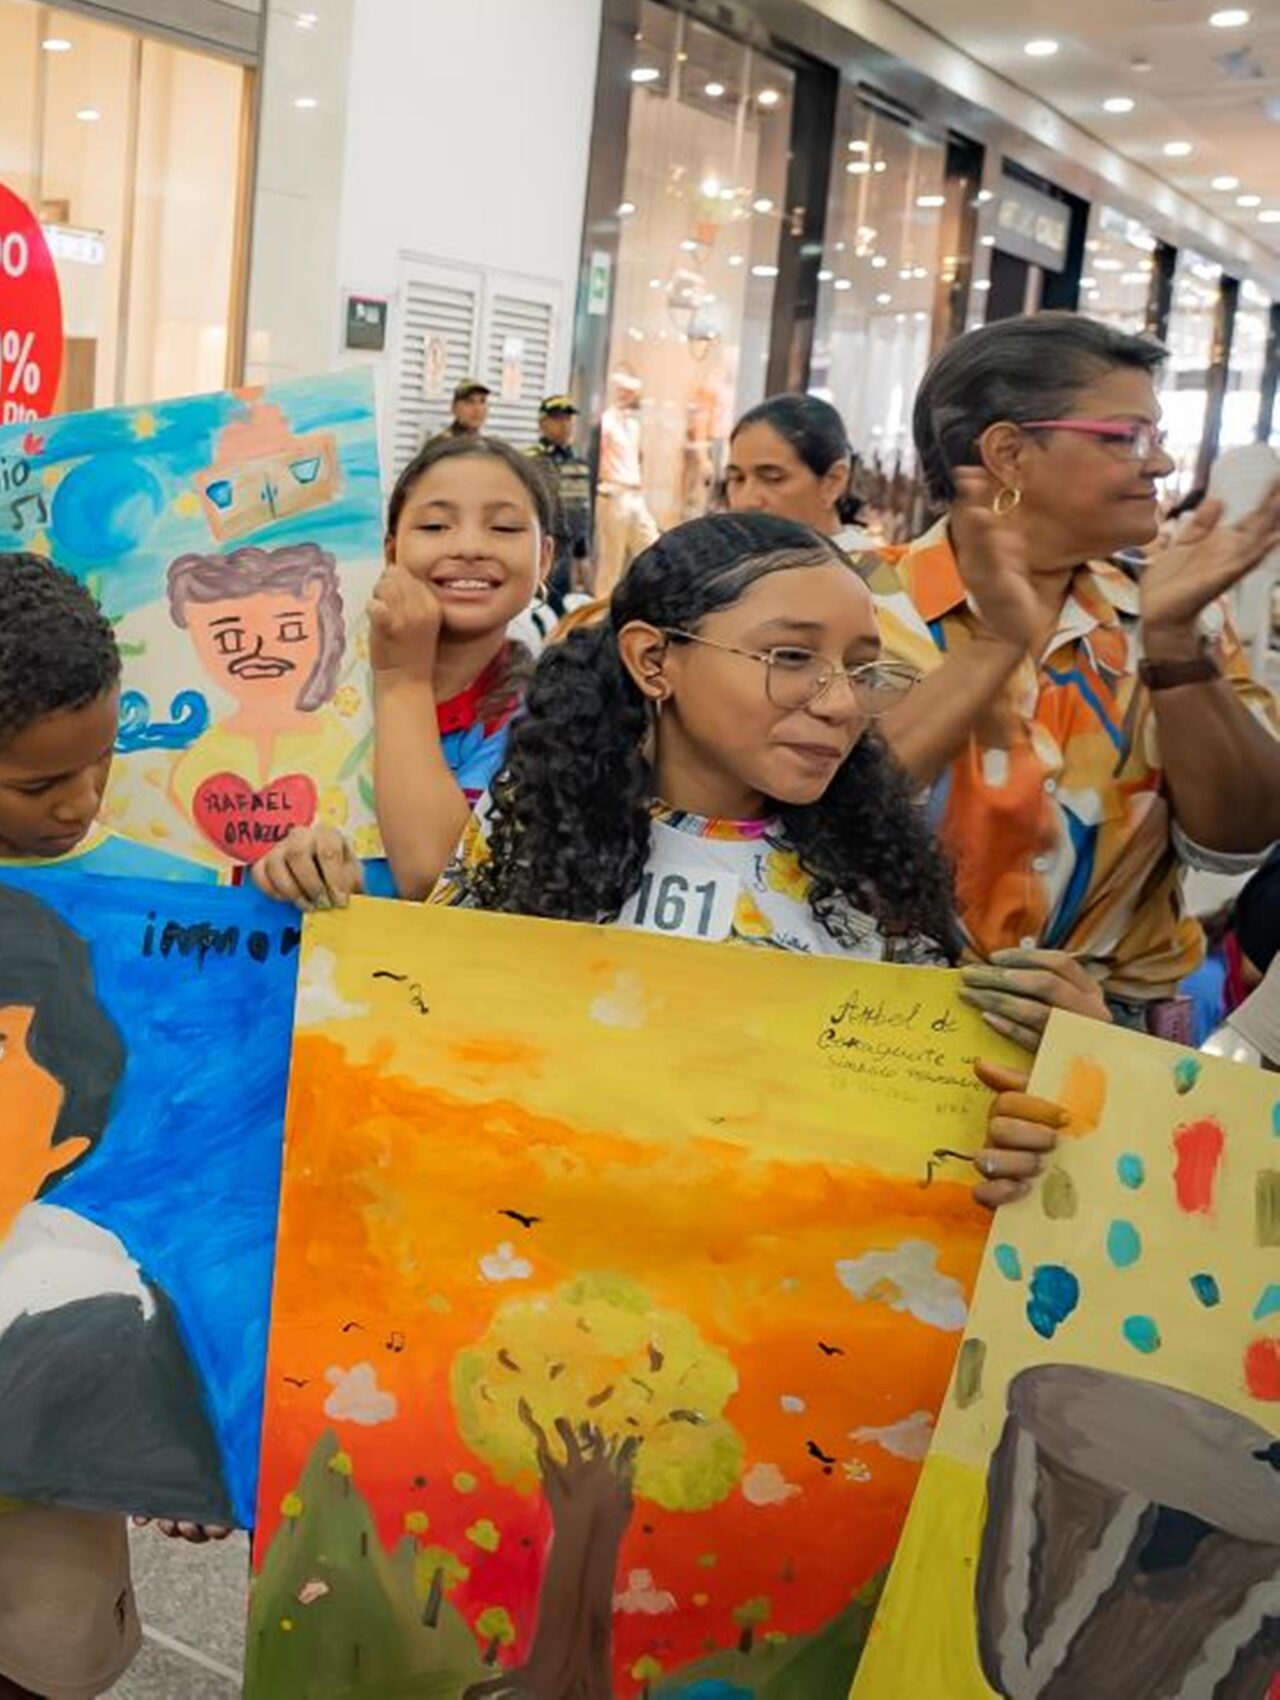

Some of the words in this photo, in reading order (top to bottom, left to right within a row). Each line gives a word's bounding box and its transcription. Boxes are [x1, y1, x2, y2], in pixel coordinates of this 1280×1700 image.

[204, 792, 291, 814] RAFAEL
[224, 820, 295, 845] OROZC
[634, 872, 716, 936] 161
